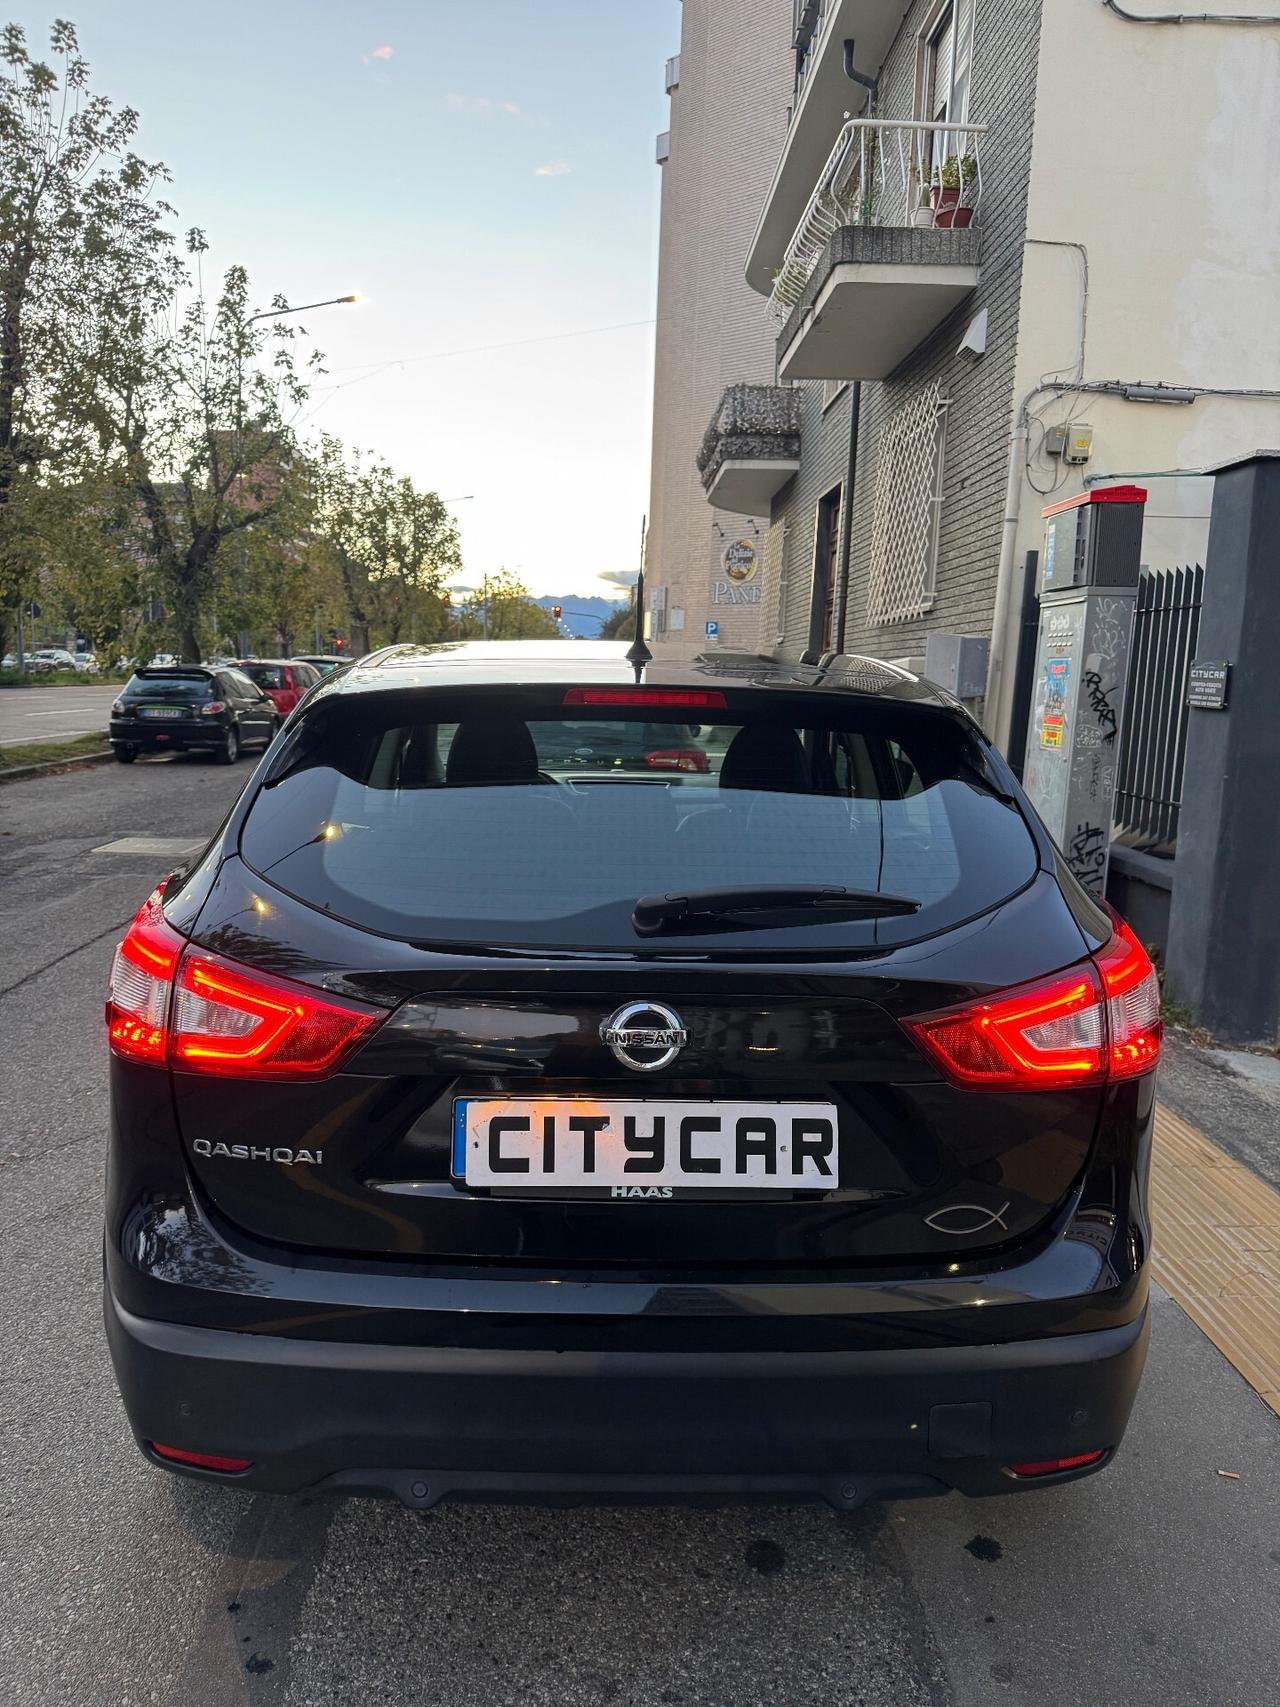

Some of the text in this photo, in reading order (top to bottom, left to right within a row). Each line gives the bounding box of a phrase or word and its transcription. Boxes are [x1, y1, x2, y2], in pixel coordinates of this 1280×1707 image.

[708, 622, 716, 634] P
[1190, 670, 1225, 679] CITYCAR
[614, 1031, 679, 1045] NISSAN
[192, 1137, 324, 1166] QASHQAI
[488, 1115, 836, 1177] CITYCAR
[610, 1186, 673, 1199] HAAS
